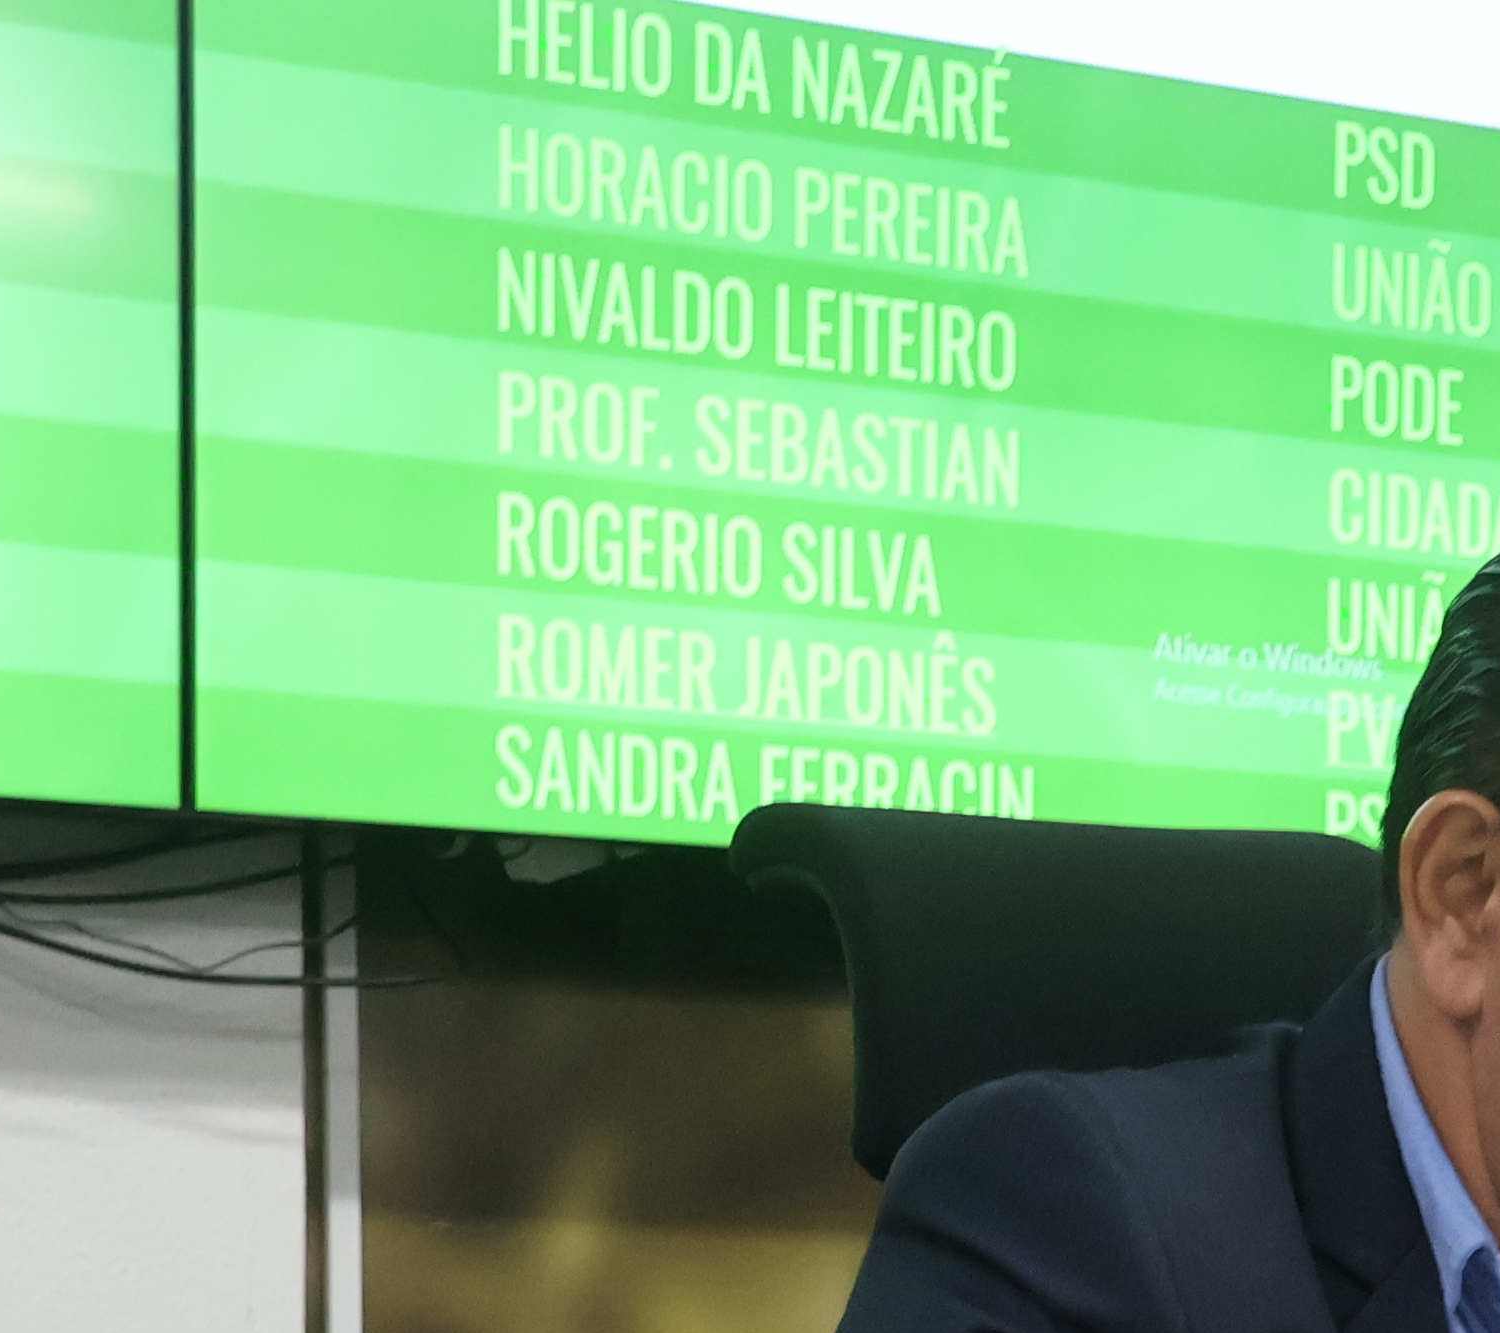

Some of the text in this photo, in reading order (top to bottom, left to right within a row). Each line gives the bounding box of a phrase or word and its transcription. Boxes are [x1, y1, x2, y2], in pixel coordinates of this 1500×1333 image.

[694, 20, 771, 115] DA
[791, 35, 1011, 149] NAZARÉ
[497, 122, 1029, 279] HORACIO PEREIRA
[1334, 120, 1435, 210] PSD
[497, 246, 1017, 392] NIVALDO LEITEIRO
[1332, 238, 1492, 339] UNIÃO
[497, 369, 1020, 509] PROF. SEBASTIAN
[1331, 354, 1465, 447] PODE
[497, 491, 941, 617] ROGERIO SILVA
[496, 613, 998, 738] ROMER JAPONÊS
[1238, 646, 1259, 670] o
[1264, 641, 1384, 682] Windows
[495, 724, 741, 823] SANDRA
[1327, 689, 1396, 769] PV
